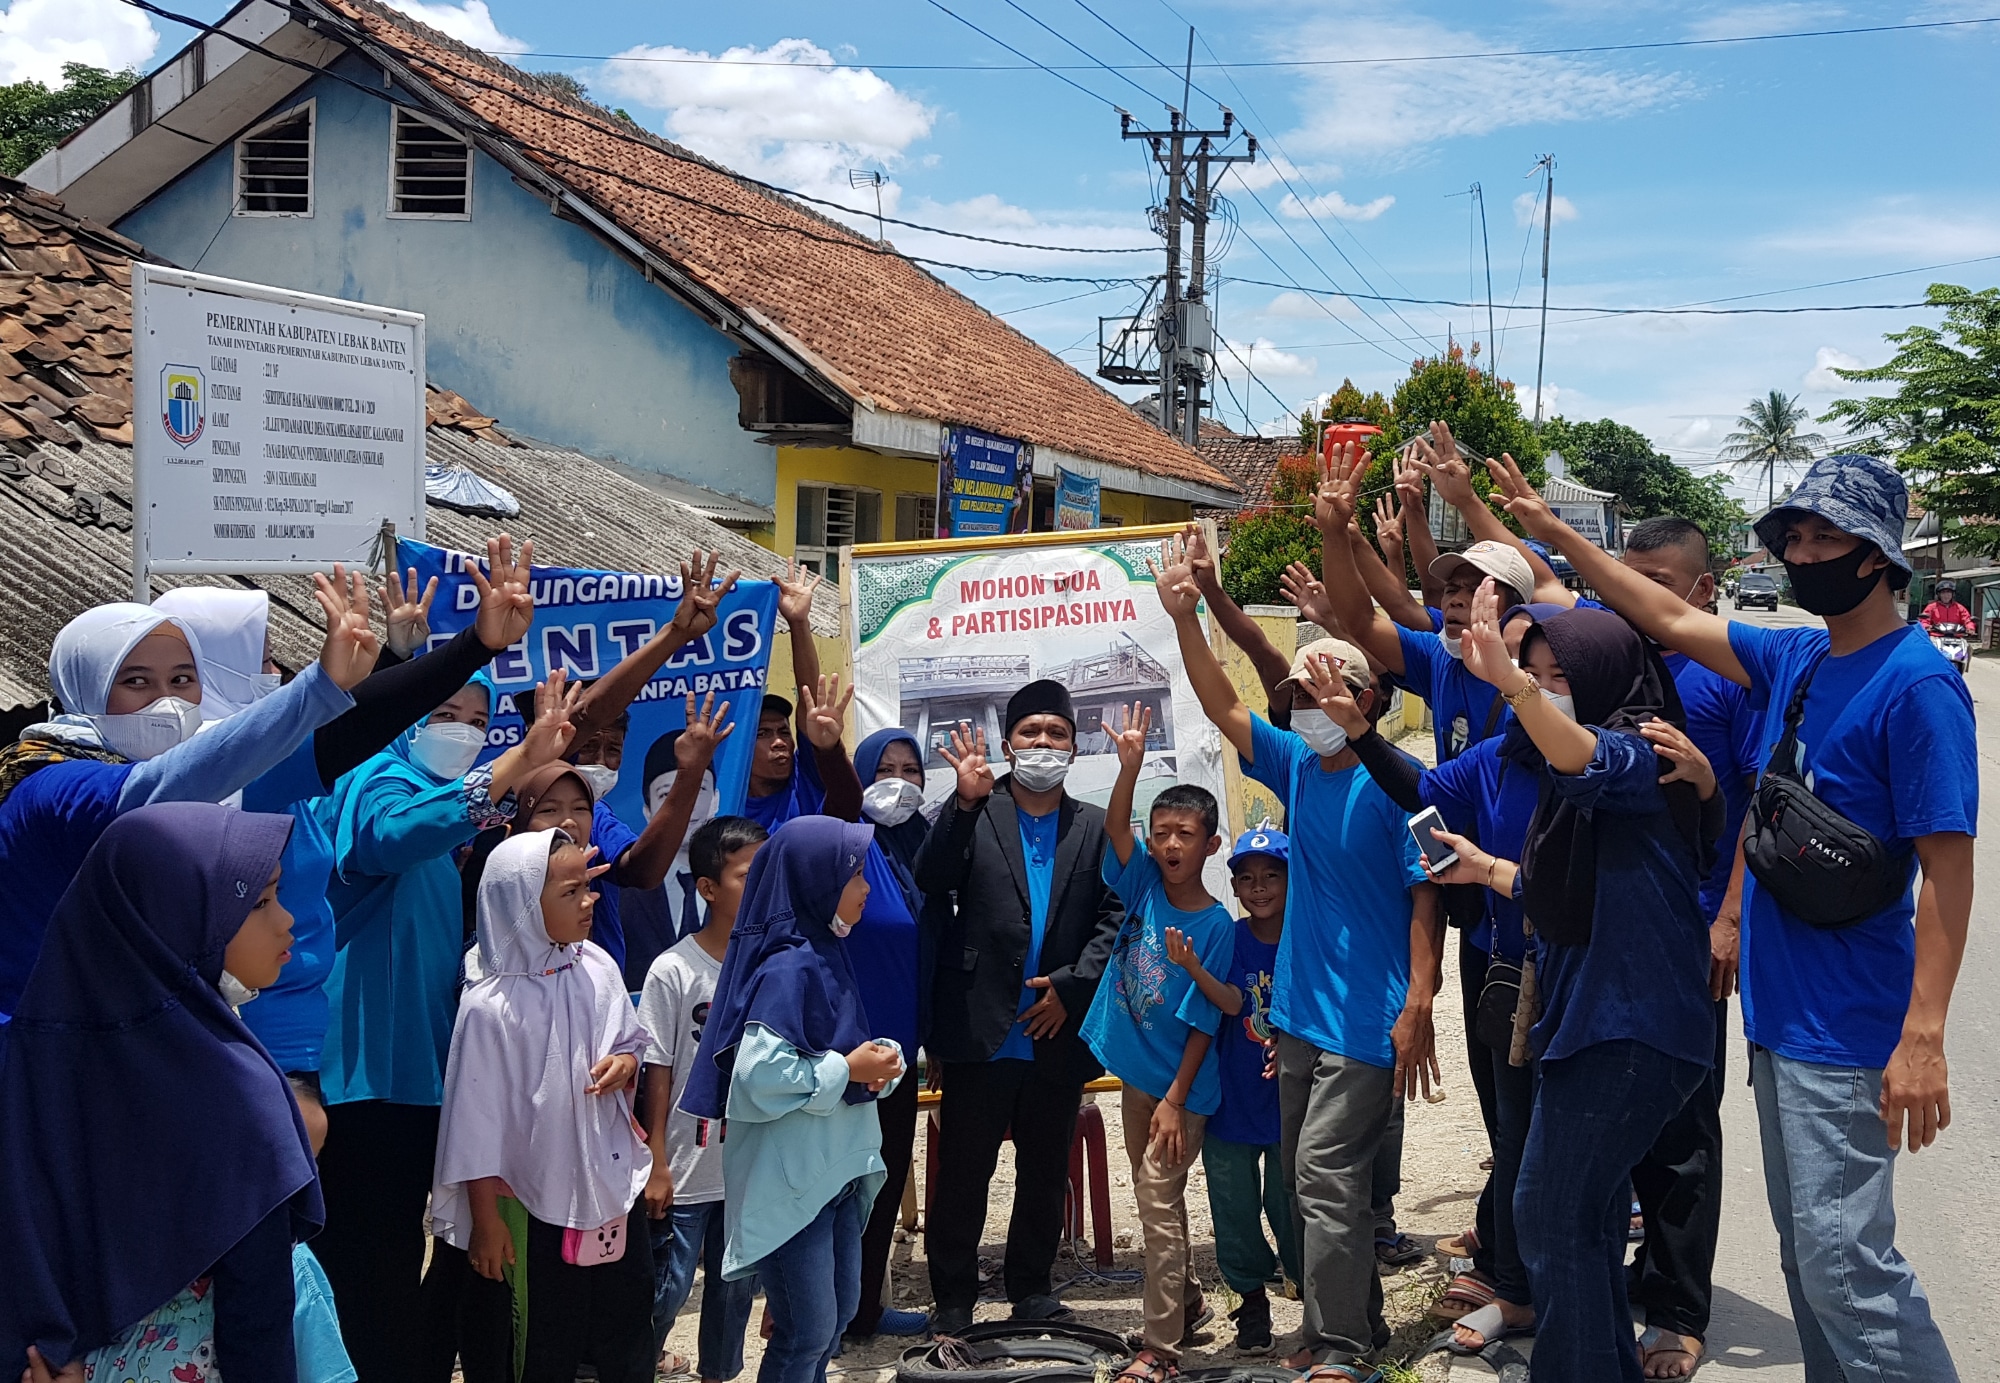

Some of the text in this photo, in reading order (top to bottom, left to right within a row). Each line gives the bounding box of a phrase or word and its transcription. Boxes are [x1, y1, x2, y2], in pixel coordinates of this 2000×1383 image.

[207, 312, 406, 355] PEMERINTAH KABUPATEN LEBAK BANTEN
[208, 335, 405, 371] TANAH INVENTARIS PEMERINTAH KABUPATEN LEBAK BANTEN
[223, 357, 237, 373] TANAH
[211, 384, 226, 400] STATUS
[228, 386, 242, 401] TANAH
[212, 412, 230, 428] ALAMAT
[212, 440, 241, 456] PENGGUNAAN
[224, 468, 247, 484] PENGGUNA
[960, 569, 1101, 604] MOHON DOA
[926, 598, 1137, 640] & PARTISIPASINYA
[1809, 837, 1852, 868] OAKLEY
